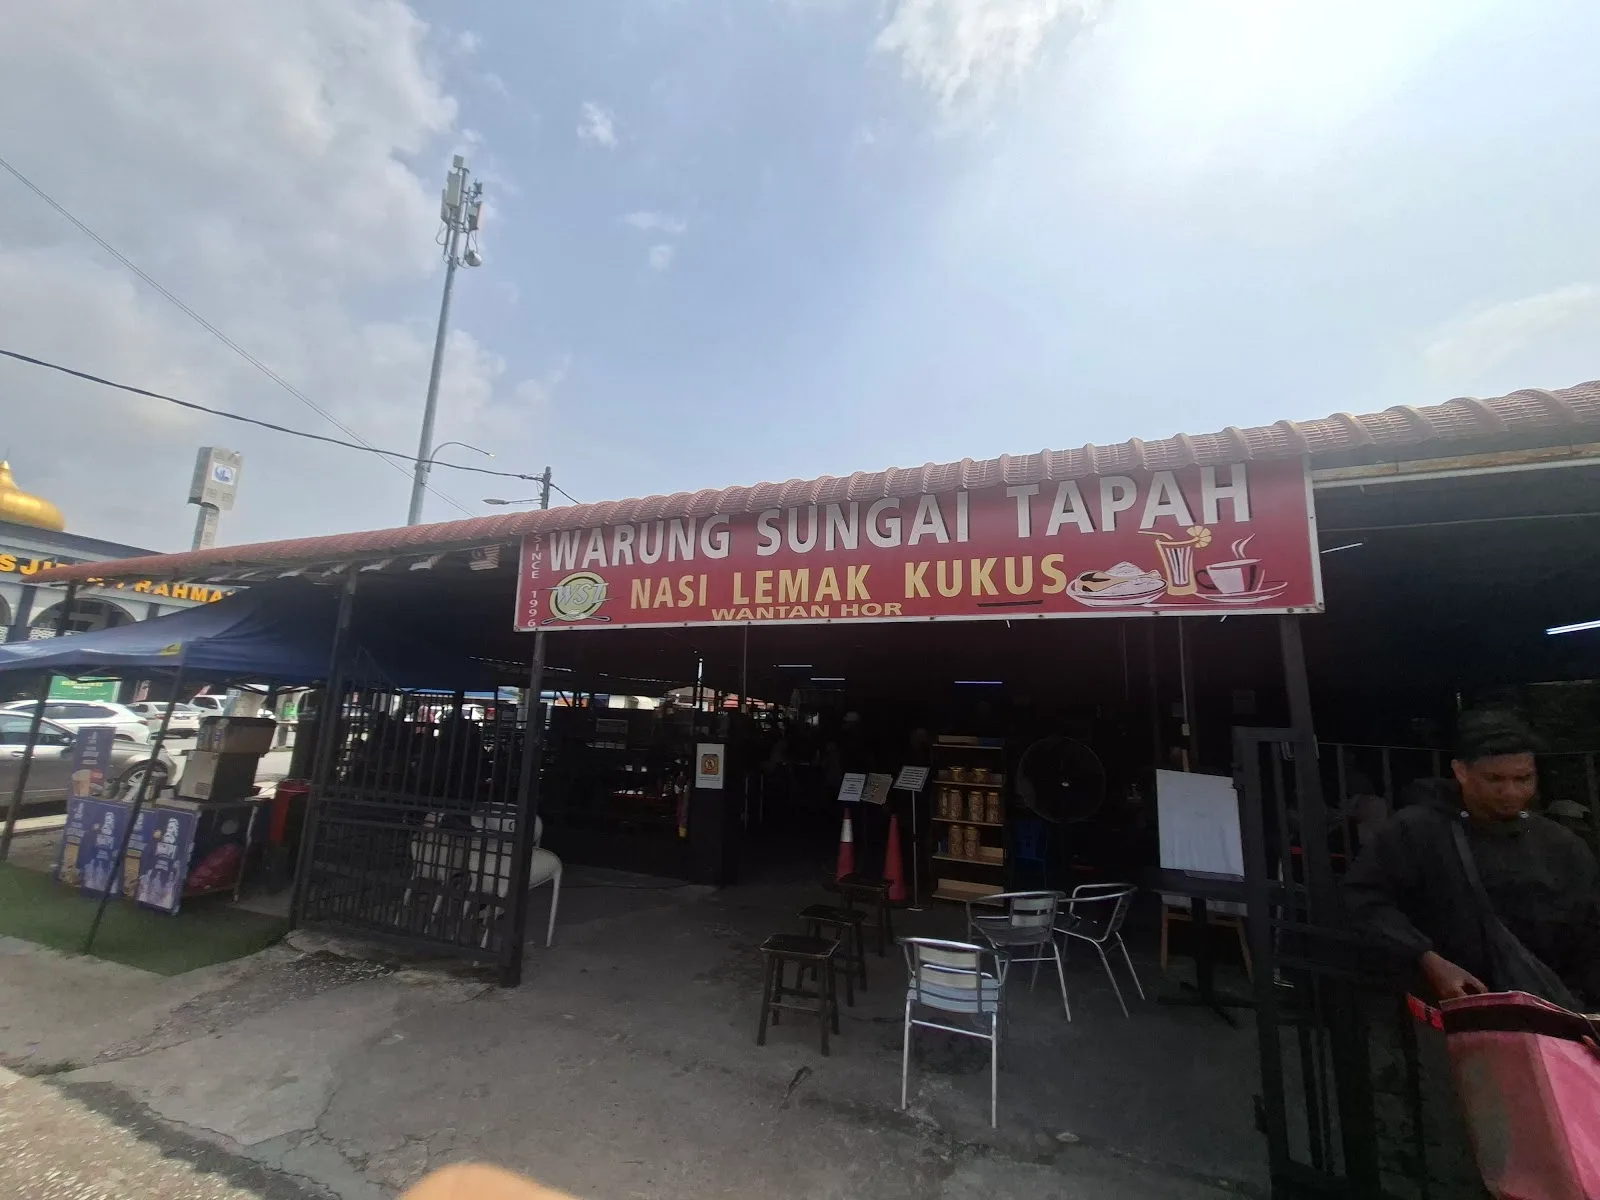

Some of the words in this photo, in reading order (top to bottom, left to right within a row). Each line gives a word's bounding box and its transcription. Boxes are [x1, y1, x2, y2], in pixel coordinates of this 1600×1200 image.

[551, 513, 731, 571] WARUNG
[757, 491, 969, 556] SUNGAI
[1006, 463, 1250, 538] TAPAH
[531, 534, 542, 579] SINCE
[630, 574, 708, 609] NASI
[733, 564, 871, 605] LEMAK
[905, 553, 1067, 599] KUKUS
[527, 591, 539, 628] 1996
[711, 604, 830, 621] WANTAN
[841, 602, 903, 616] HOR
